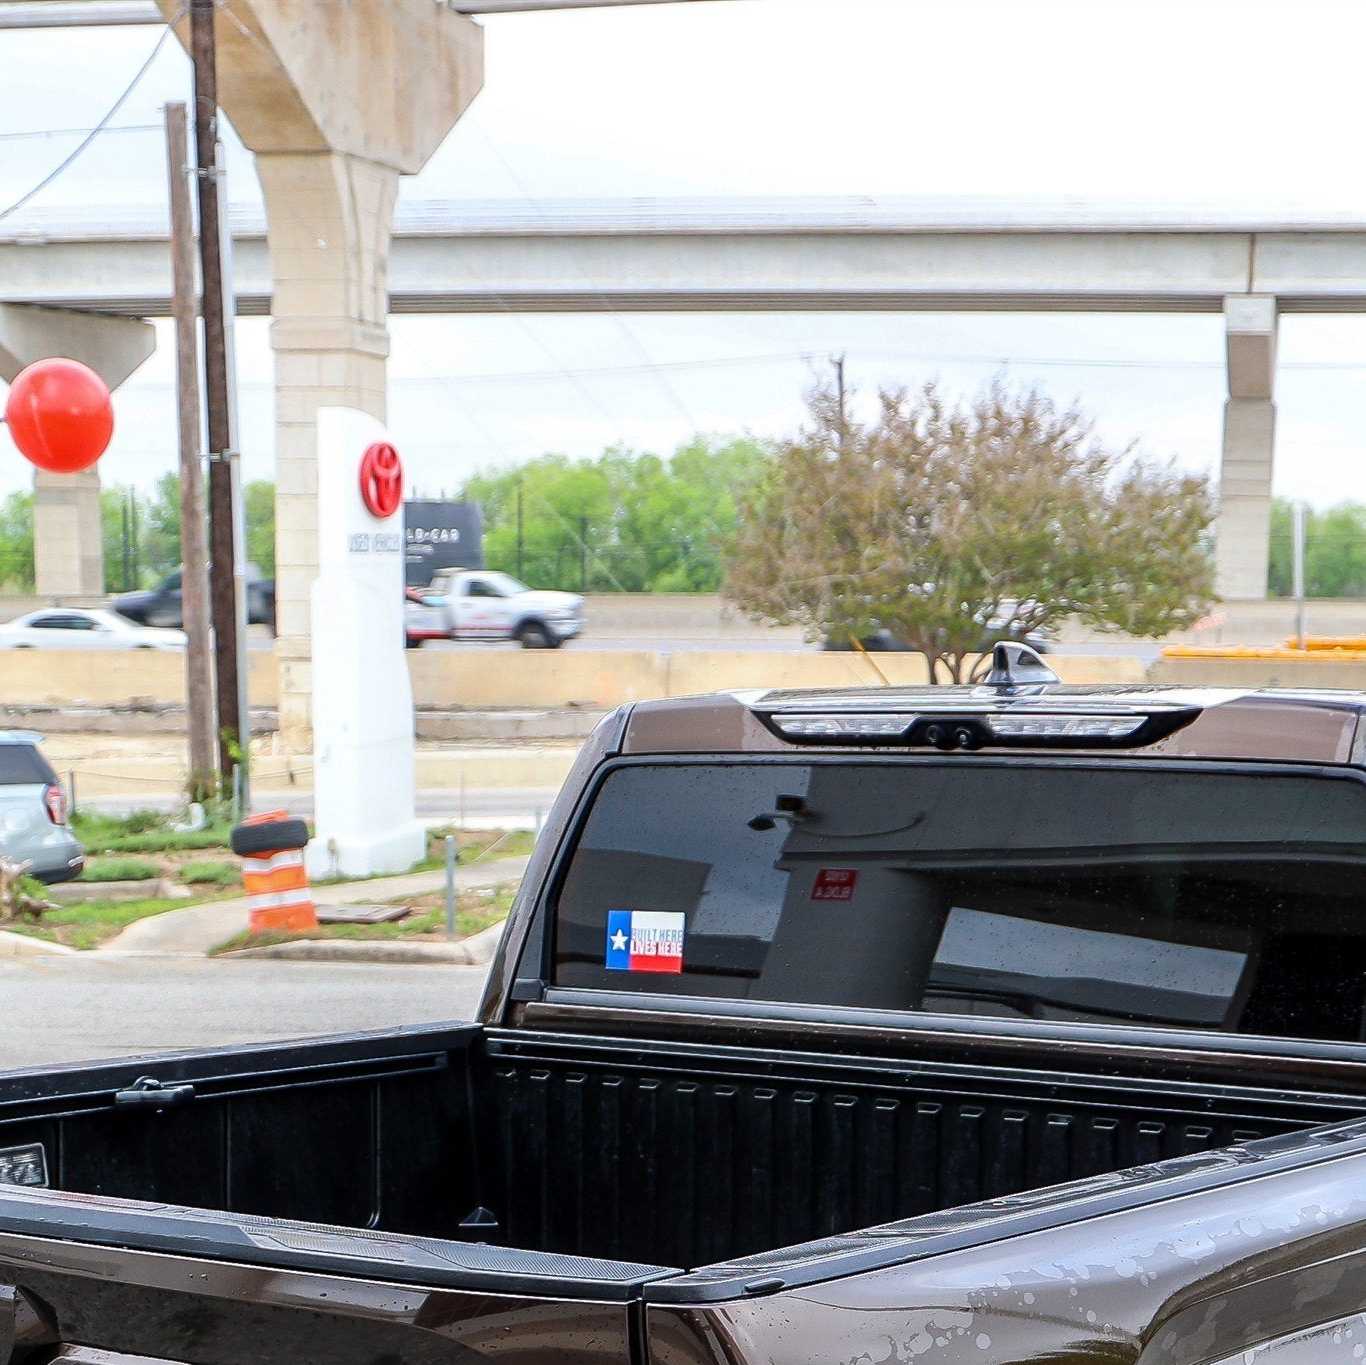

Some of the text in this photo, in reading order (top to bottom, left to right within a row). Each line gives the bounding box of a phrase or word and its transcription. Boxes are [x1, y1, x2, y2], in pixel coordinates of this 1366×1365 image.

[632, 928, 684, 943] BUILT HERE
[630, 940, 683, 956] LIVES HERE
